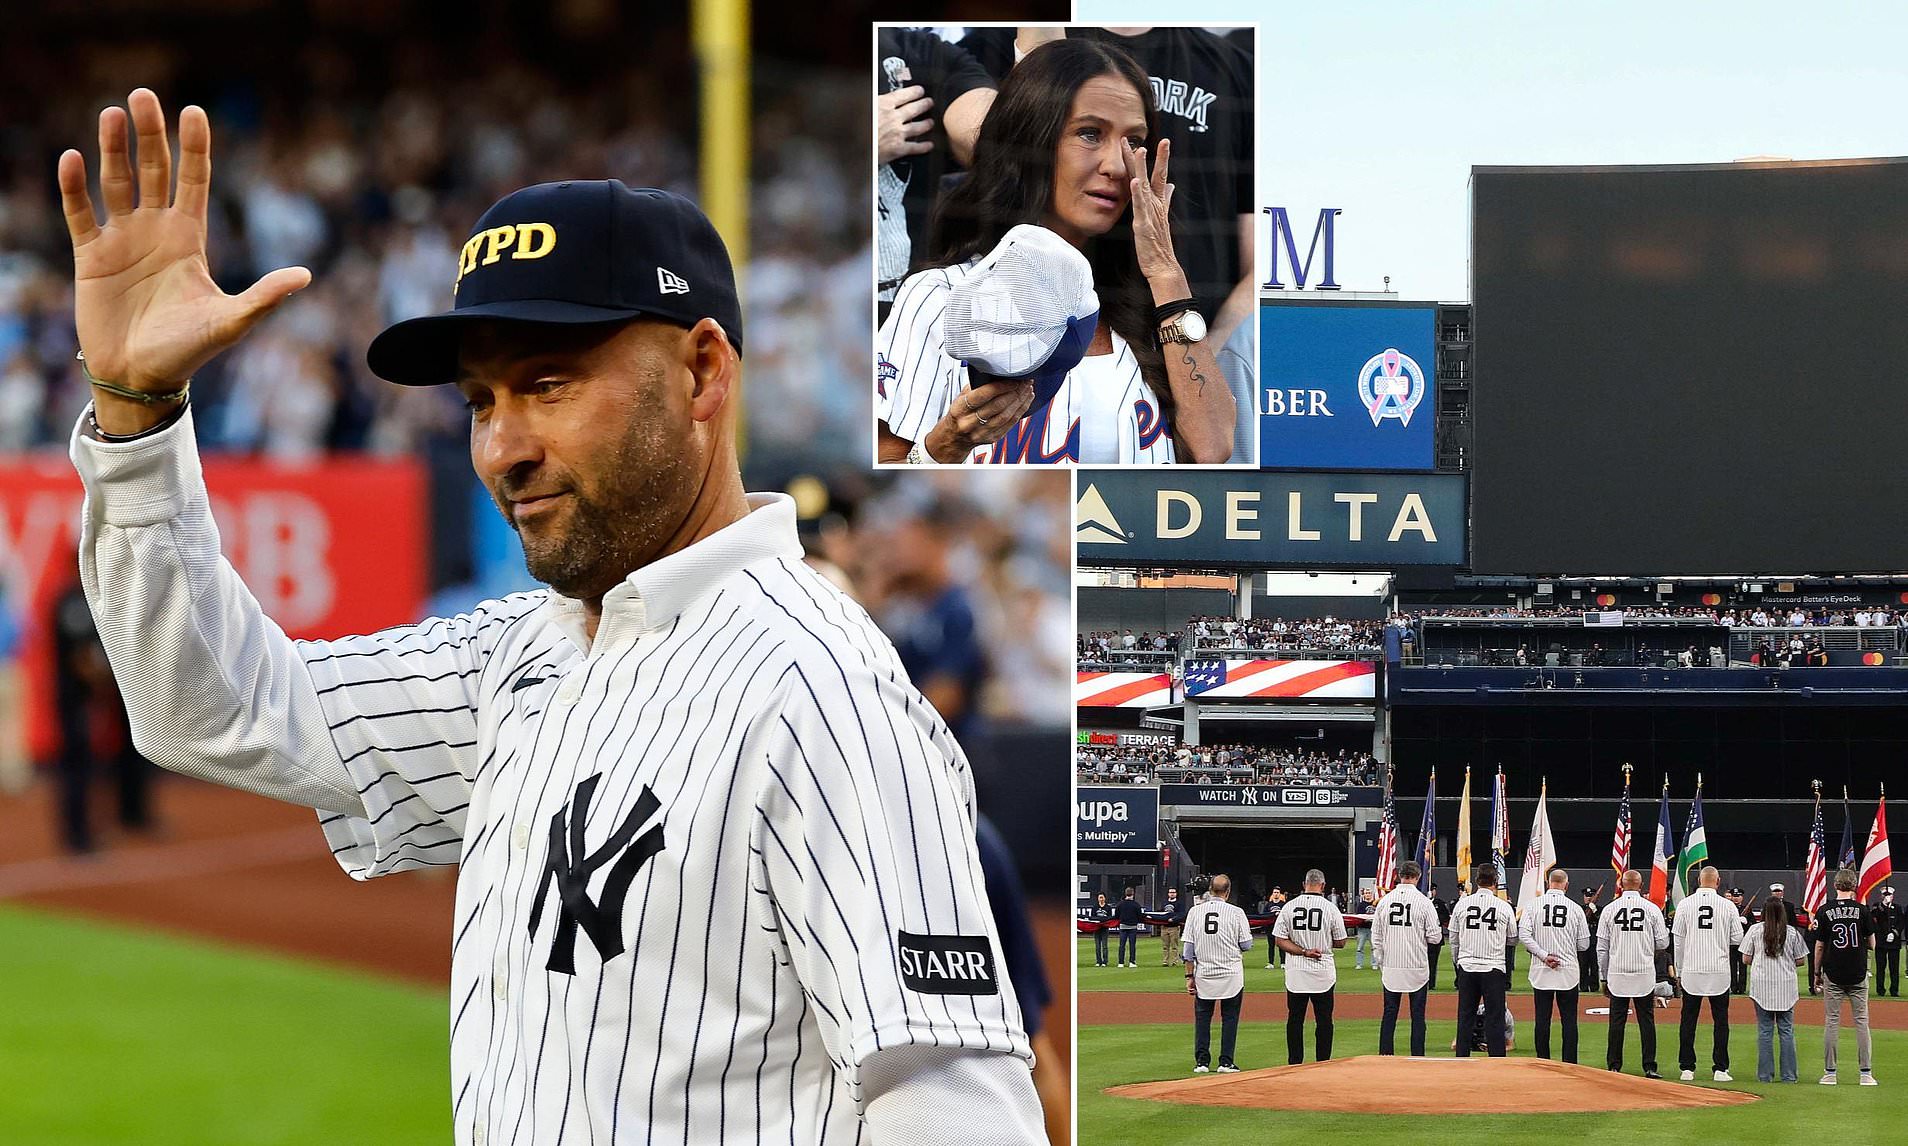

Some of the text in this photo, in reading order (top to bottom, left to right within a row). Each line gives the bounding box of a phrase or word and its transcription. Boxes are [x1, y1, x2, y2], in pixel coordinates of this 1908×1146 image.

[1156, 489, 1438, 543] DELTA
[1761, 595, 1801, 604] Mastercard
[1830, 595, 1843, 605] Eye
[1843, 595, 1862, 603] Deck
[1121, 734, 1176, 747] TERRACE
[1200, 790, 1237, 801] WATCH
[1262, 791, 1277, 802] ON
[1286, 792, 1306, 801] YES
[1204, 911, 1219, 935] 6
[1293, 907, 1323, 931] 20
[1389, 902, 1412, 927] 21
[1466, 905, 1497, 931] 24
[1543, 904, 1567, 928] 18
[1614, 907, 1645, 932] 42
[1698, 905, 1714, 930] 2
[1825, 906, 1860, 921] PIAZZA
[1832, 922, 1858, 949] 31
[901, 946, 990, 980] STARR
